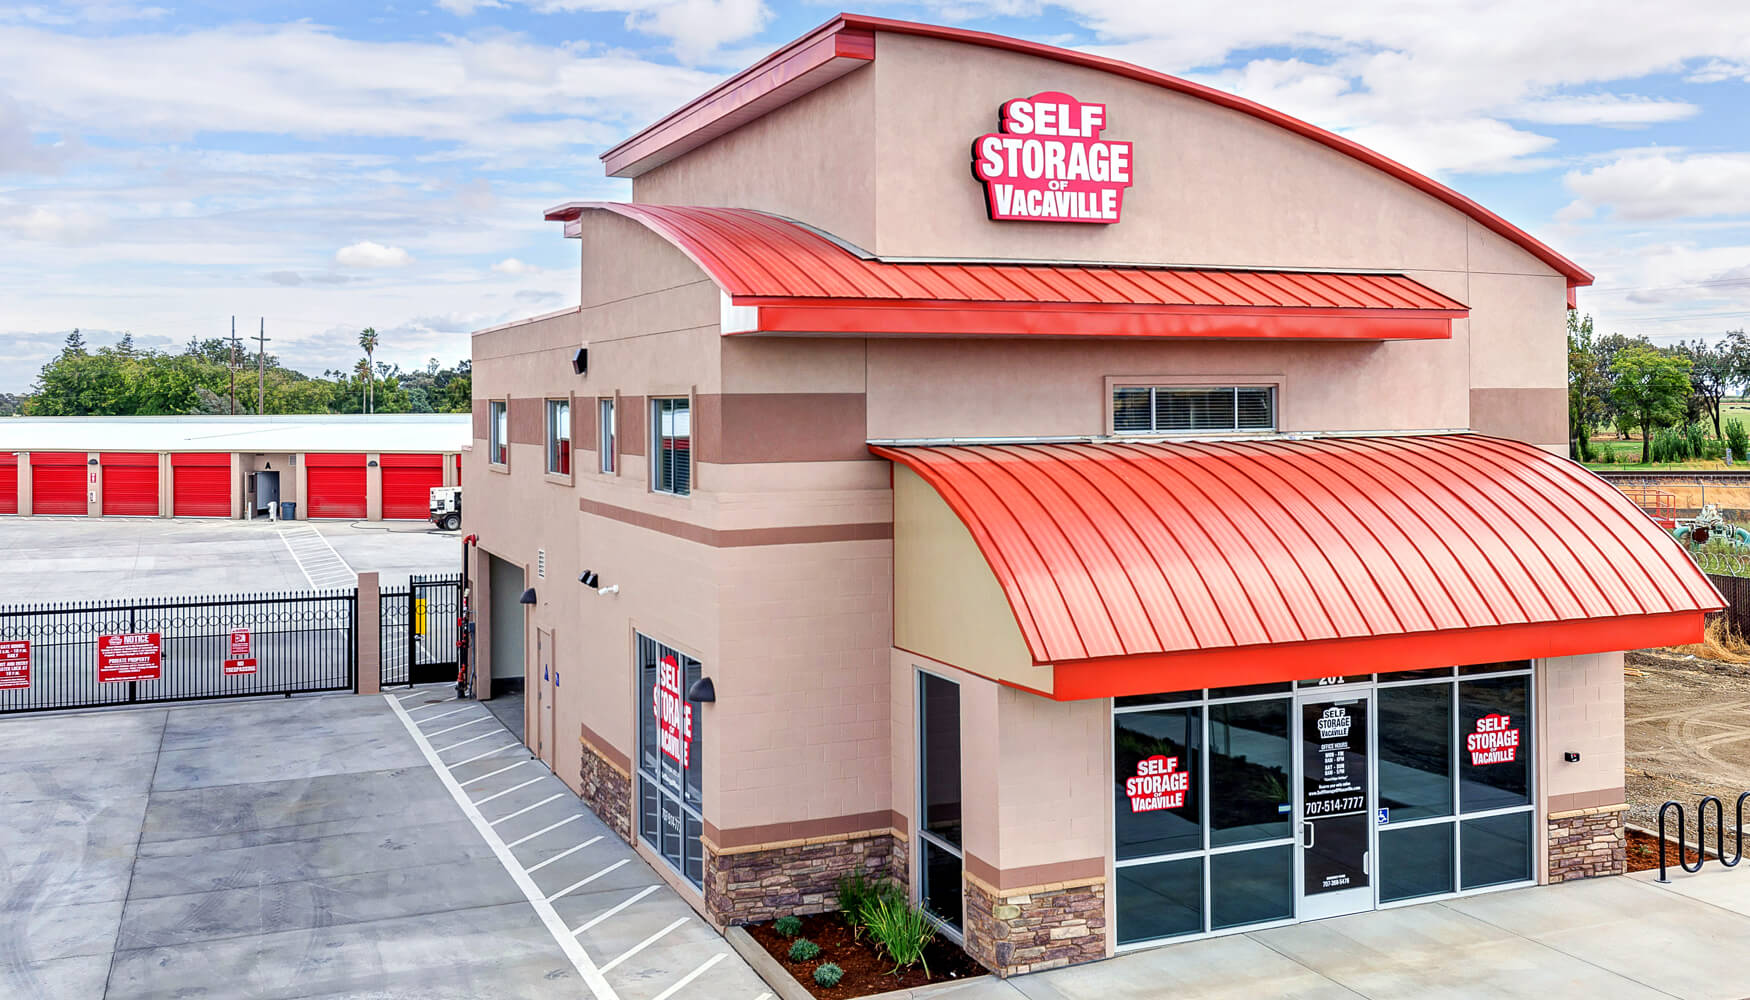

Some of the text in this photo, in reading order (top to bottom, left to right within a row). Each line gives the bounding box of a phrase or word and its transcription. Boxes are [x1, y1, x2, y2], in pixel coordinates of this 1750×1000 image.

[1008, 101, 1103, 138] SELF
[982, 136, 1129, 183] STORAGE
[1048, 180, 1069, 191] OF
[994, 184, 1117, 220] VACAVILLE
[264, 461, 272, 470] A
[124, 635, 150, 645] NOTICE
[1324, 709, 1345, 719] SELF
[1318, 717, 1350, 730] STORAGE
[1321, 727, 1347, 737] VACAVILLE
[1476, 716, 1509, 732] SELF
[1468, 729, 1518, 751] STORAGE
[1472, 748, 1514, 765] VACAVILLE
[1137, 758, 1177, 776] SELF
[1127, 773, 1188, 796] STORAGE
[1131, 792, 1182, 811] VACAVILLE
[1305, 796, 1364, 816] 707-514-7777
